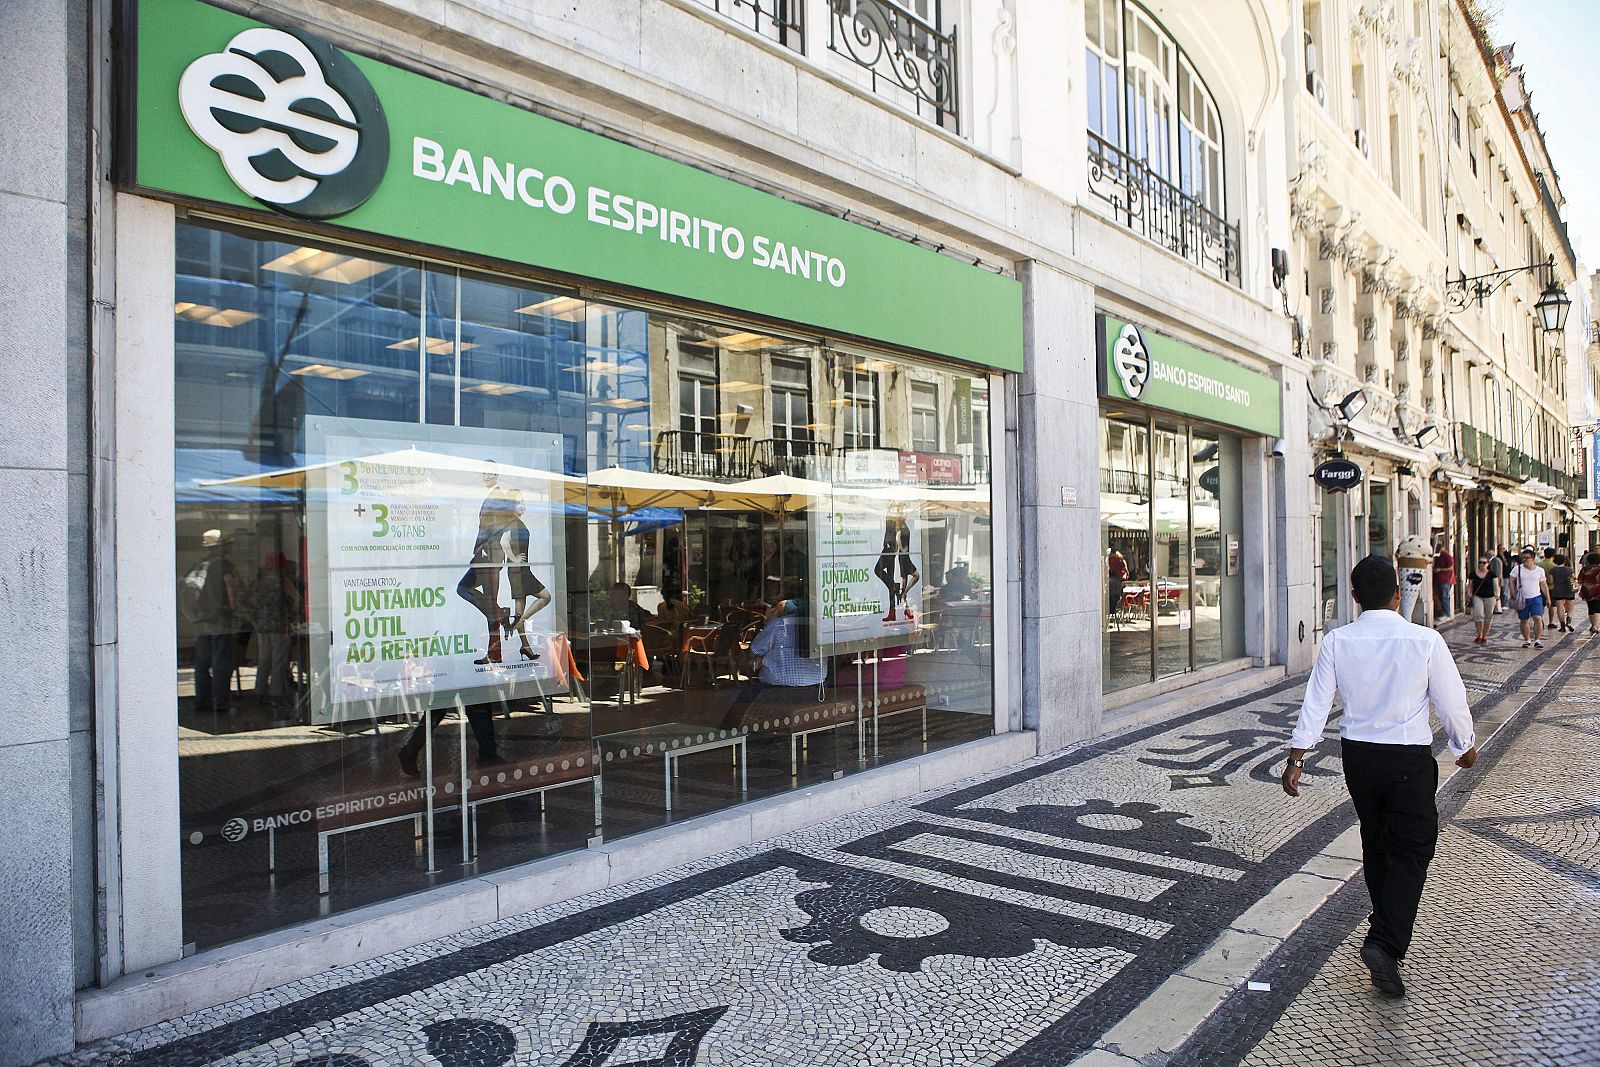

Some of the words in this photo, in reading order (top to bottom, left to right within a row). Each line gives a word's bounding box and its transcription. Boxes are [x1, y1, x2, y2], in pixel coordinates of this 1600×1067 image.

[413, 136, 576, 214] BANCO
[588, 186, 745, 260] ESPIRITO
[752, 235, 846, 288] SANTO
[1153, 360, 1186, 387] BANCO
[1187, 371, 1224, 399] ESPIRITO
[1225, 384, 1250, 407] SANTO
[340, 461, 359, 496] 3
[1321, 469, 1355, 480] Farggi
[371, 503, 390, 538] 3
[343, 578, 377, 587] VANTAGEM
[822, 565, 870, 587] JUNTÁMOS
[344, 582, 446, 616] JUNTÁMOS
[822, 588, 830, 603] O
[345, 618, 361, 640] O
[364, 611, 407, 639] ÚTIL
[346, 641, 376, 664] AO
[381, 630, 478, 661] RENTÁVEL.
[253, 809, 312, 832] BANCO
[316, 795, 385, 820] ESPIRITO
[388, 785, 437, 806] SANTO
